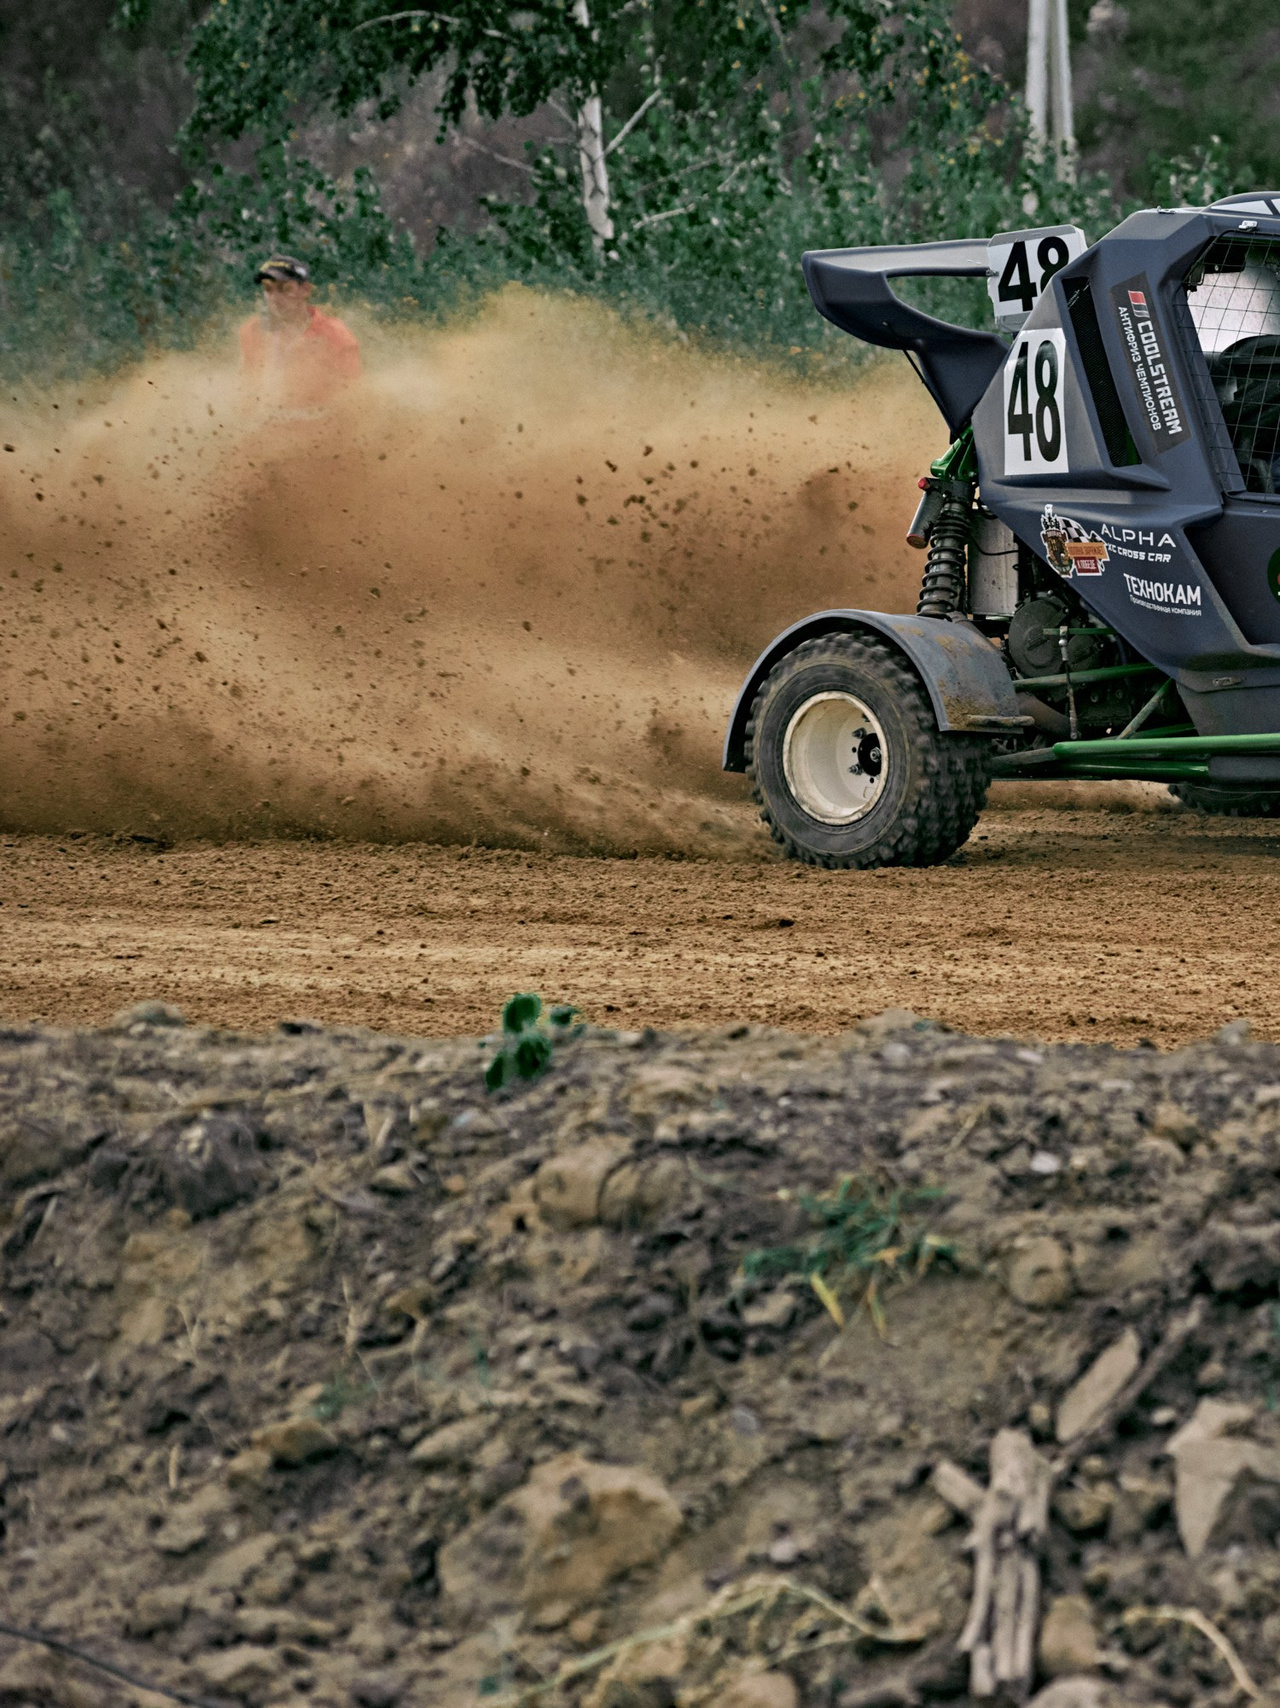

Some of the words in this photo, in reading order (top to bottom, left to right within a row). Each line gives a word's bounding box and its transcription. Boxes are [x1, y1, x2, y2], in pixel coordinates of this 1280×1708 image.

[998, 236, 1069, 312] 48
[1007, 340, 1062, 462] 48
[1118, 306, 1142, 363] АНТИФРИЗ
[1135, 363, 1162, 431] ЧЕМПИОНОВ
[1137, 320, 1183, 435] COOLSTREAM
[1101, 523, 1177, 548] ALPHA
[1117, 546, 1146, 561] CROSS
[1147, 552, 1172, 563] CAR
[1123, 573, 1202, 606] ТЕХНОКАМ
